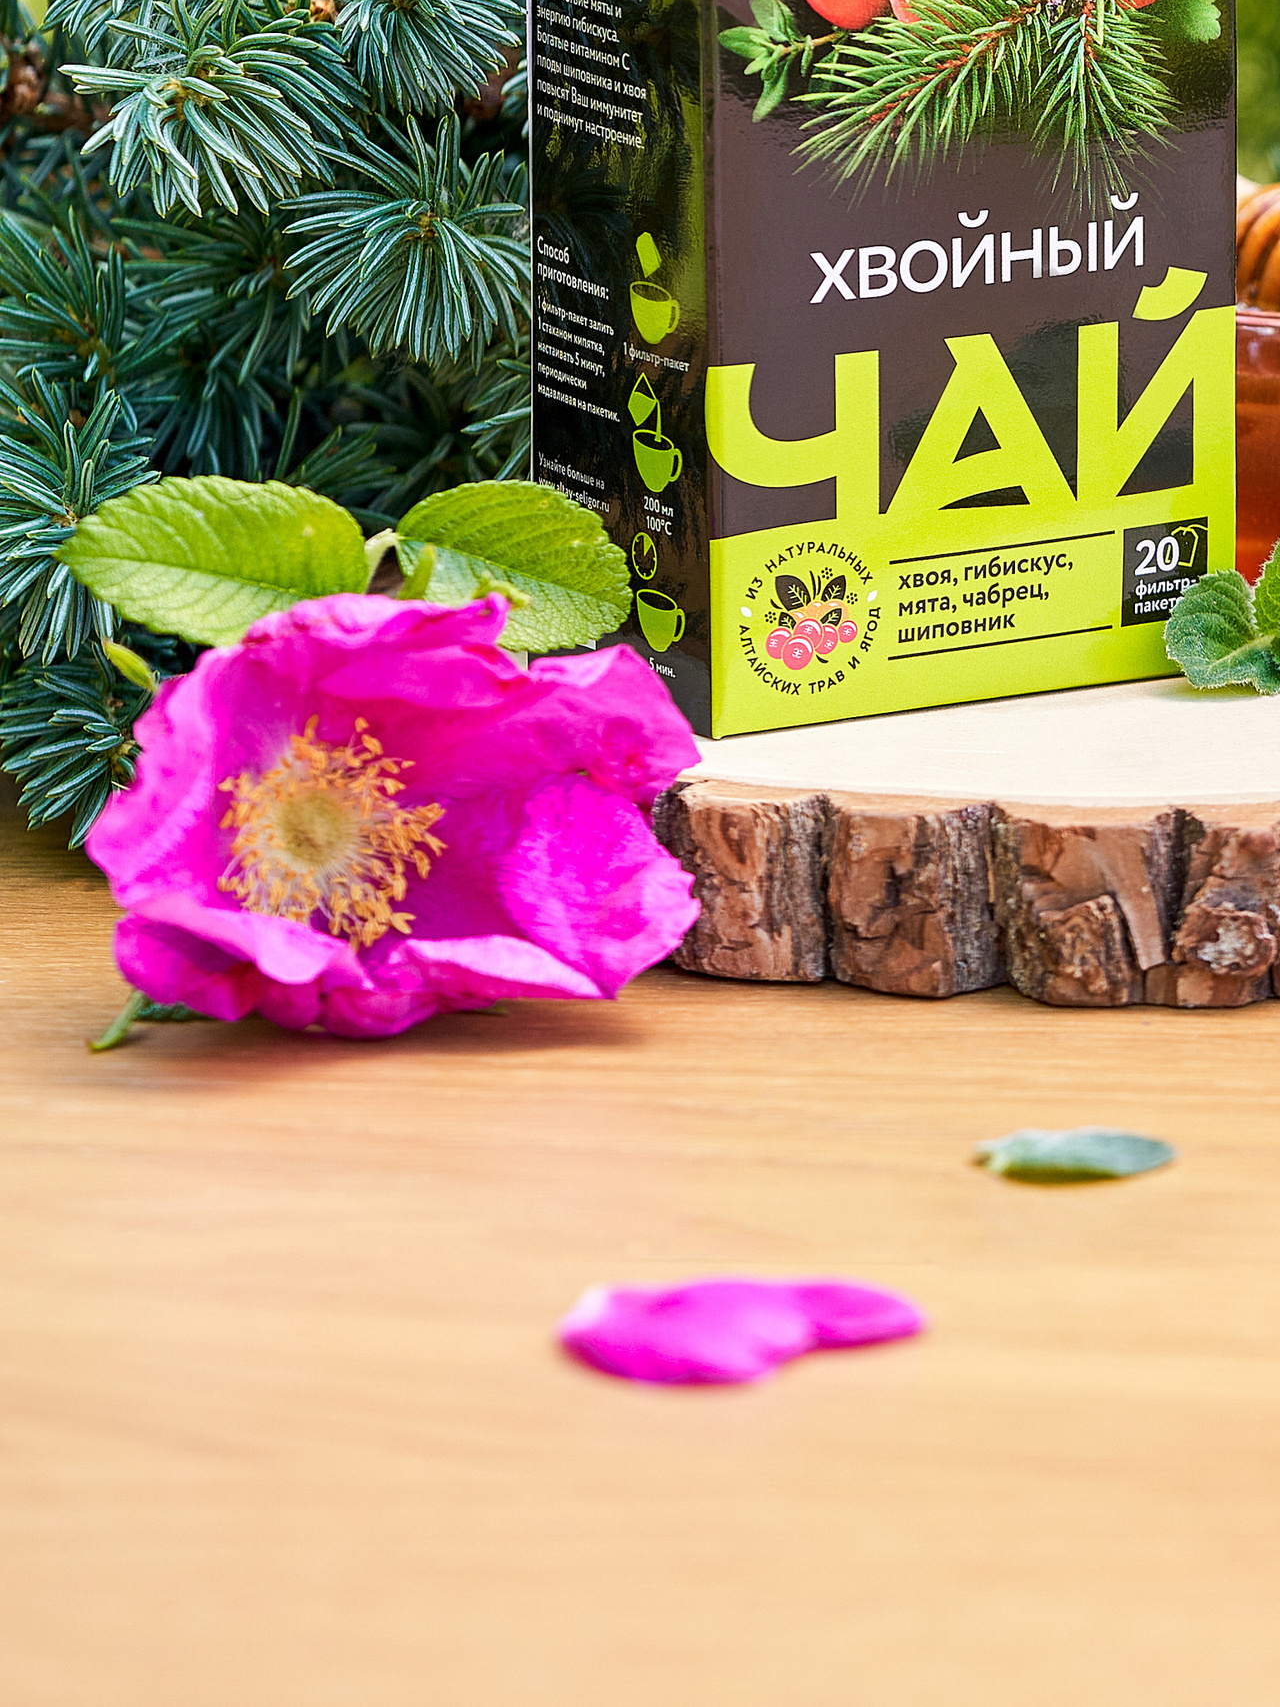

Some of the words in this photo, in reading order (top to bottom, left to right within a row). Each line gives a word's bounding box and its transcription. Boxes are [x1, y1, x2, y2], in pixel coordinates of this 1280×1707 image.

[536, 5, 571, 27] энергию
[572, 16, 620, 43] гибискуса.
[615, 6, 622, 18] и
[537, 24, 569, 52] Богатые
[570, 42, 620, 67] витамином
[536, 54, 562, 75] плоды
[563, 64, 613, 91] шиповника
[614, 80, 621, 93] и
[622, 82, 647, 100] хвоя
[537, 79, 570, 101] повысят
[571, 86, 589, 108] Ваш
[590, 98, 643, 124] иммунитет
[537, 103, 543, 115] и
[543, 105, 584, 133] поднимут
[585, 121, 645, 149] настроение.
[537, 235, 570, 265] Способ
[809, 191, 1146, 306] ХВОЙНЫЙ
[537, 263, 610, 300] приготовления:
[537, 296, 542, 308] 1
[541, 299, 588, 327] фильтр-пакет
[588, 318, 615, 336] залить
[537, 316, 541, 330] 1
[541, 323, 573, 343] стаканом
[573, 333, 605, 356] кипятка,
[537, 341, 575, 365] настаивать
[575, 351, 580, 366] 5
[580, 358, 606, 377] минут,
[537, 362, 587, 390] периодически
[623, 342, 628, 356] 1
[628, 343, 690, 373] фильтр-пакет
[537, 383, 577, 407] надавливая
[577, 397, 587, 410] на
[587, 401, 621, 423] пакетик.
[705, 265, 1236, 520] ЧАЙ
[538, 451, 566, 476] Узнайте
[566, 464, 595, 487] больше
[595, 478, 605, 491] на
[643, 495, 661, 513] 200
[661, 505, 674, 518] мл
[745, 576, 763, 600] ИЗ
[764, 541, 874, 585] НАТУРАЛЬНЫХ
[897, 568, 958, 590] хвоя,
[964, 551, 1074, 582] гибискус,
[1134, 535, 1180, 576] 20
[898, 595, 957, 617] мята,
[962, 581, 1050, 609] чабрец,
[1135, 578, 1197, 600] фильтр-
[897, 611, 1015, 644] шиповник
[649, 656, 655, 671] 5
[655, 663, 677, 678] мин.
[739, 624, 801, 695] АЛТАЙСКИХ
[808, 670, 845, 694] ТРАВ
[847, 655, 861, 670] И
[860, 606, 881, 652] ЯГОД
